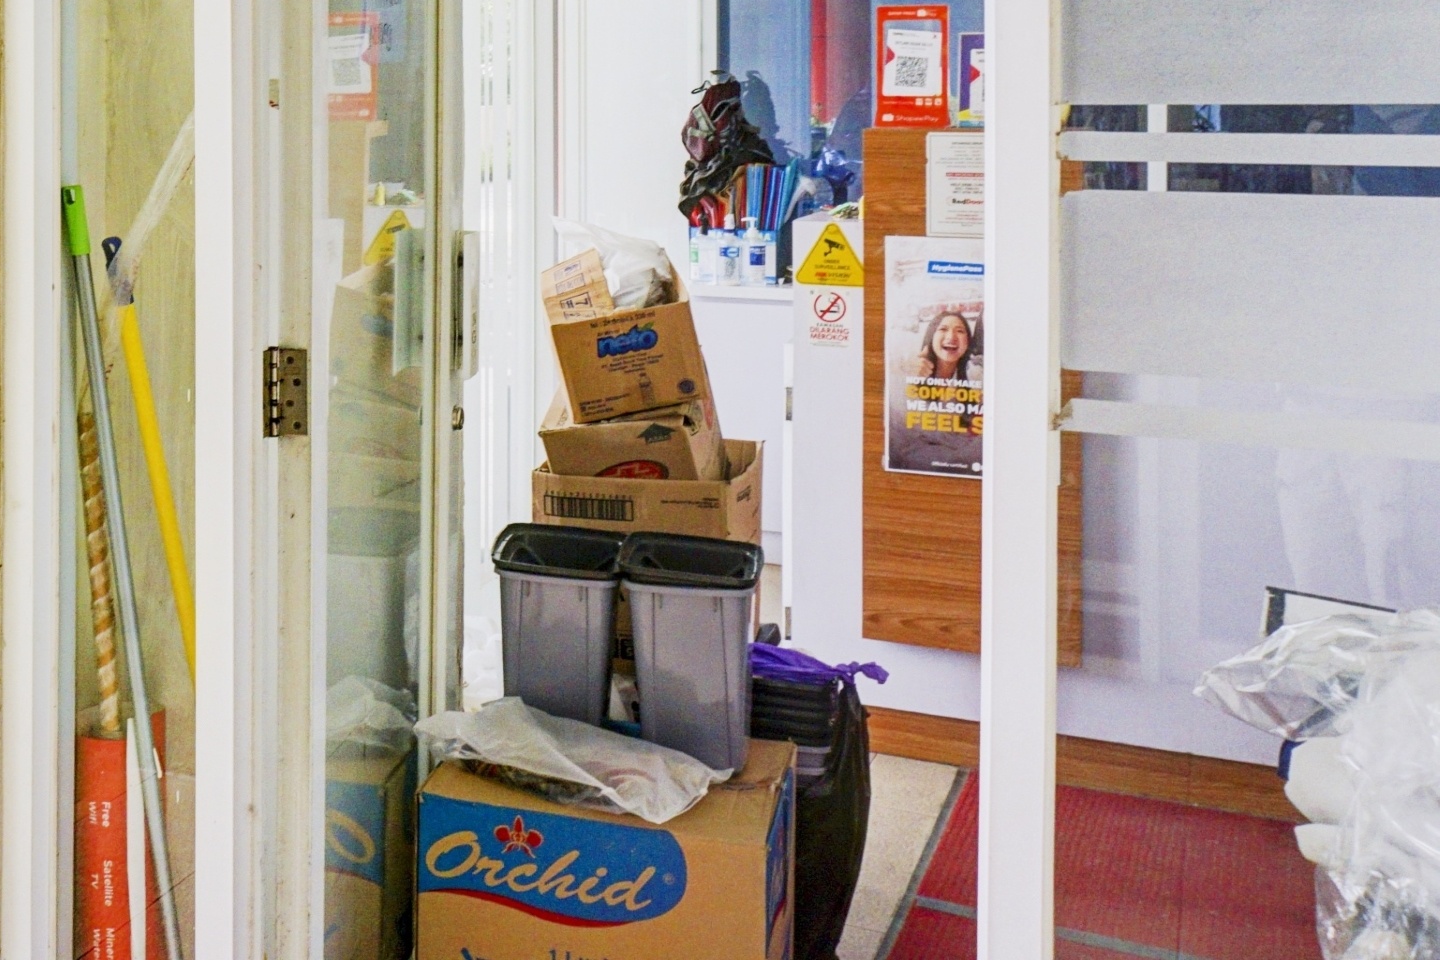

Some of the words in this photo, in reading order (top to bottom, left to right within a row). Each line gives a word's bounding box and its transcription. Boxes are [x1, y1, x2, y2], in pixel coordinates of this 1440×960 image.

[809, 326, 850, 335] DILARANG
[809, 333, 849, 341] MEROKOK
[905, 376, 927, 385] NOT
[926, 377, 953, 387] ONLY
[955, 379, 983, 388] MAKE
[905, 385, 983, 402] COMFOR
[906, 400, 927, 411] WE
[927, 401, 966, 414] ALSO
[905, 411, 968, 433] FEEL
[88, 801, 98, 825] Wifi
[100, 801, 111, 828] Free
[91, 873, 99, 890] TV
[425, 830, 658, 911] Orchid
[103, 860, 114, 907] Satellite
[93, 928, 101, 960] Wate
[106, 927, 115, 960] Miner
